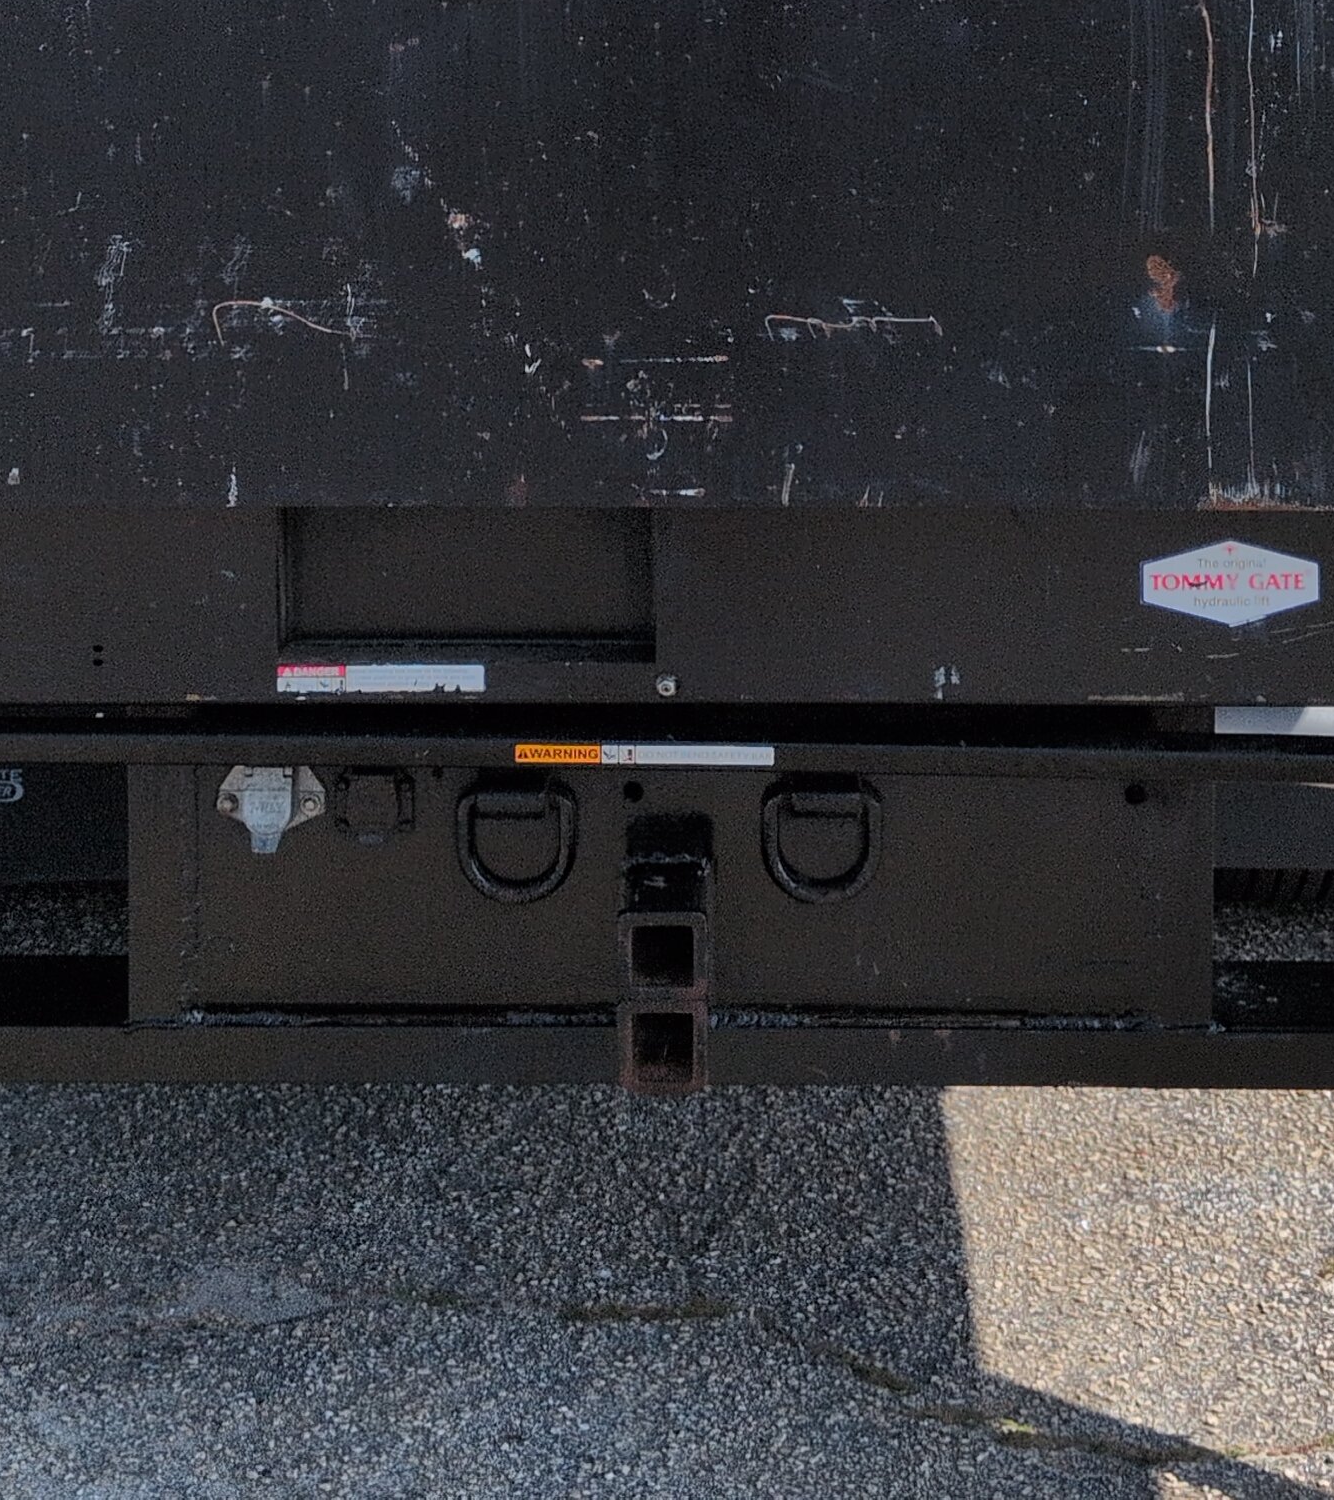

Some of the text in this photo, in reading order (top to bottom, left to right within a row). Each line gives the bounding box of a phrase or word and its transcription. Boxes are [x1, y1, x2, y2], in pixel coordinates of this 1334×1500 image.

[1198, 558, 1219, 568] The
[1151, 573, 1306, 591] TOMMY GATE
[1194, 595, 1251, 607] hydraulic
[295, 667, 340, 676] DANGER
[530, 748, 599, 760] WARNING
